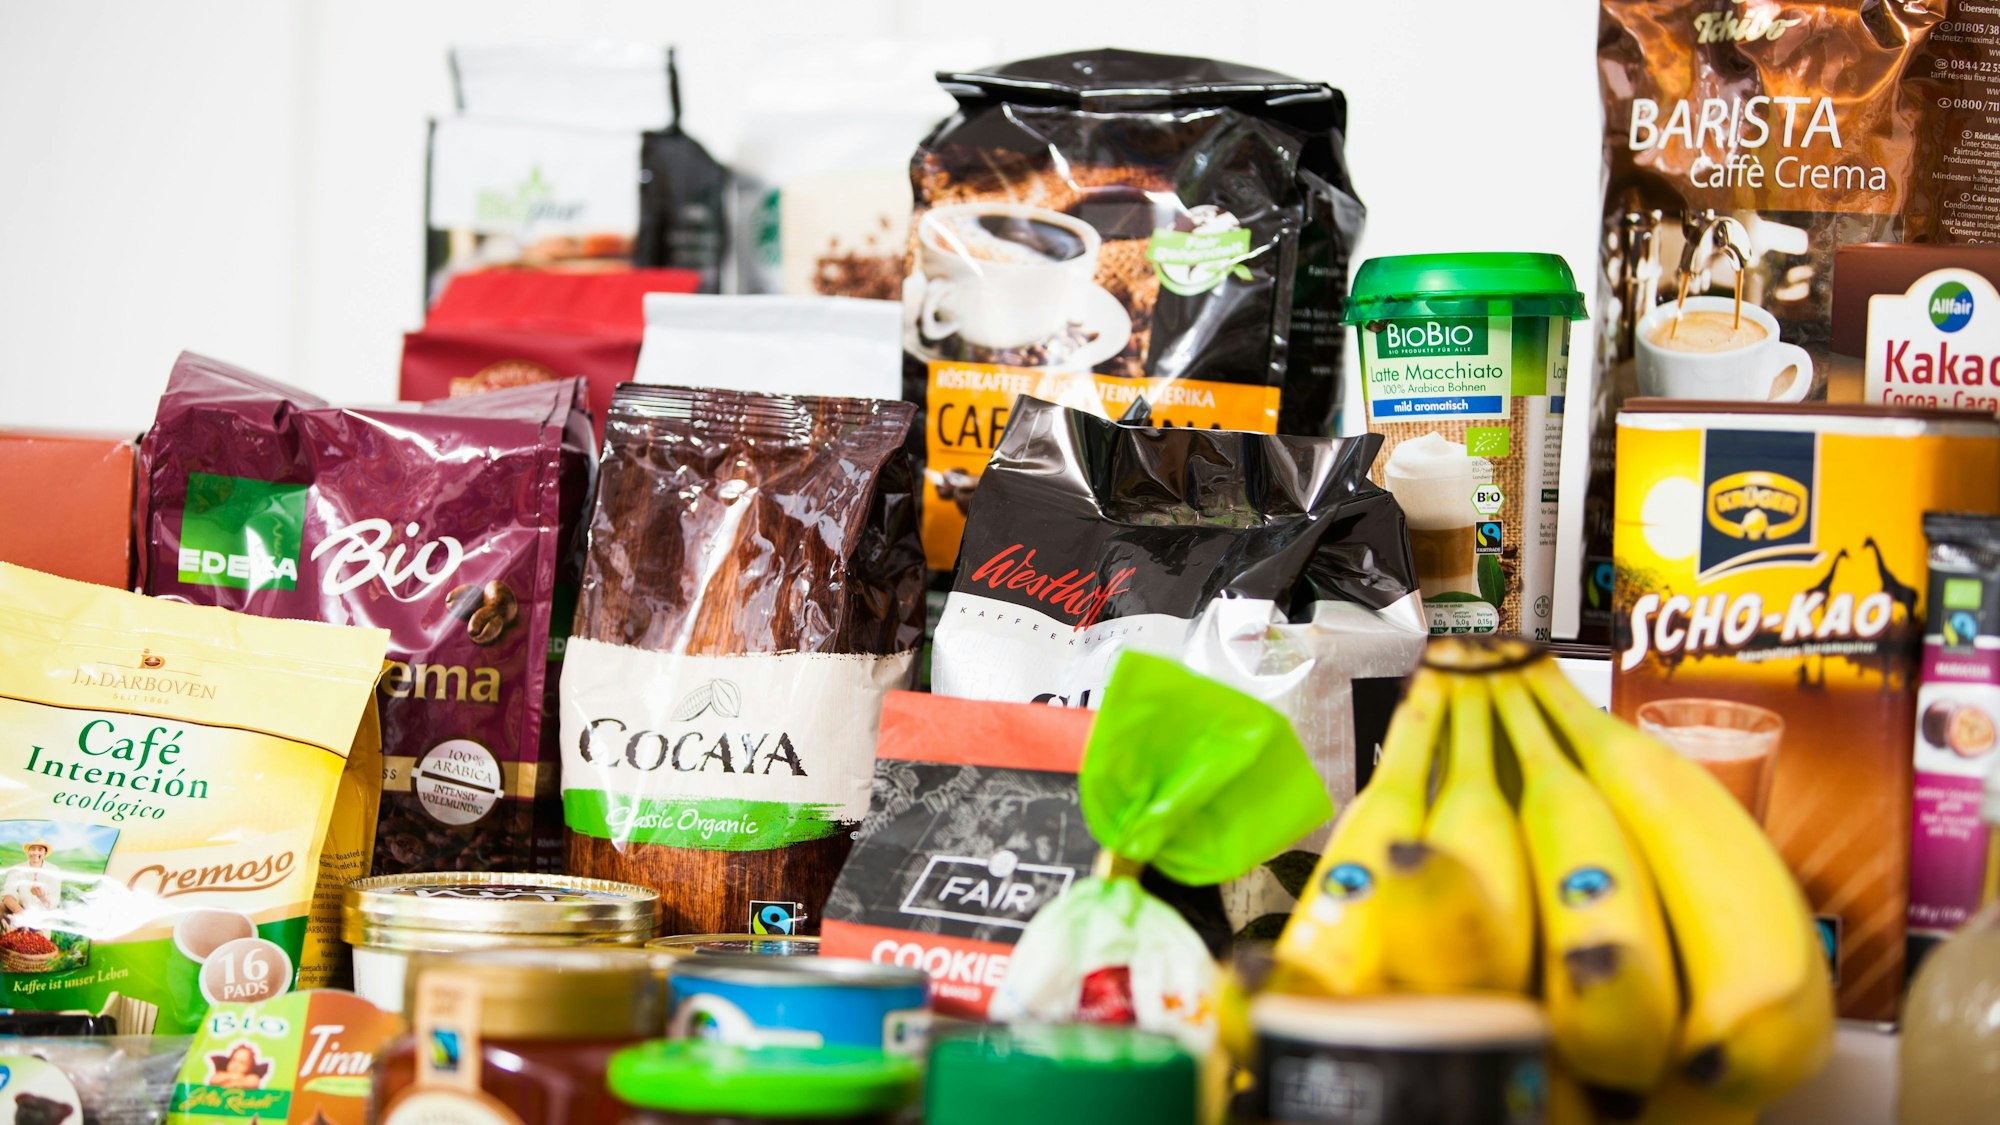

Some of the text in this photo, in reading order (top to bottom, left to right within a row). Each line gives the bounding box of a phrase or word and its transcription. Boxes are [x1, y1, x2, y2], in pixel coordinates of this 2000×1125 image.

[1694, 10, 1801, 43] Tchibo
[1954, 22, 2000, 35] 01805/38
[1965, 36, 1994, 45] maximal
[1930, 71, 1947, 79] tarif
[1948, 71, 1972, 80] réseau
[1974, 73, 1986, 82] fixe
[1951, 60, 1978, 71] 0844
[1980, 62, 1991, 72] 22
[1629, 96, 1842, 150] BARISTA
[1961, 140, 1980, 148] Unter
[1943, 155, 1986, 166] Produzenten
[1689, 155, 1886, 190] Caffè Crema
[1932, 172, 1972, 182] Mindestens
[1973, 175, 1994, 183] haltbar
[1944, 200, 1983, 211] Conditionné
[1972, 194, 1987, 202] Café
[1955, 219, 1961, 227] la
[1962, 219, 1976, 227] date
[1957, 211, 1994, 220] consommer
[1950, 227, 1997, 238] Conserver dans
[1931, 298, 1972, 315] Allfair
[936, 368, 1032, 394] RÖSTKAFFEE
[1371, 361, 1503, 382] Latte Macchiato
[1384, 382, 1486, 395] 100% Arabica Bohnen
[1394, 399, 1469, 412] mild aromatisch
[938, 403, 1008, 449] CAF
[312, 518, 464, 603] Bio
[971, 543, 1137, 632] Westhoff
[1621, 592, 1893, 673] SCHO-KAO
[381, 661, 500, 702] ema
[78, 719, 183, 771] Café
[448, 749, 485, 767] 100%
[24, 745, 208, 799] Intención
[432, 759, 493, 784] ARABICA
[422, 792, 484, 815] VOLLMUNDIG
[433, 784, 478, 801] INTENSIV
[53, 791, 166, 821] ecológico
[677, 809, 759, 840] Organic
[127, 851, 294, 895] Cremoso
[938, 876, 1036, 913] FAIR
[218, 949, 269, 984] 16
[872, 939, 1008, 987] COOKIE
[13, 967, 128, 995] Kaffee ist unser Leben
[223, 981, 269, 1000] PADS
